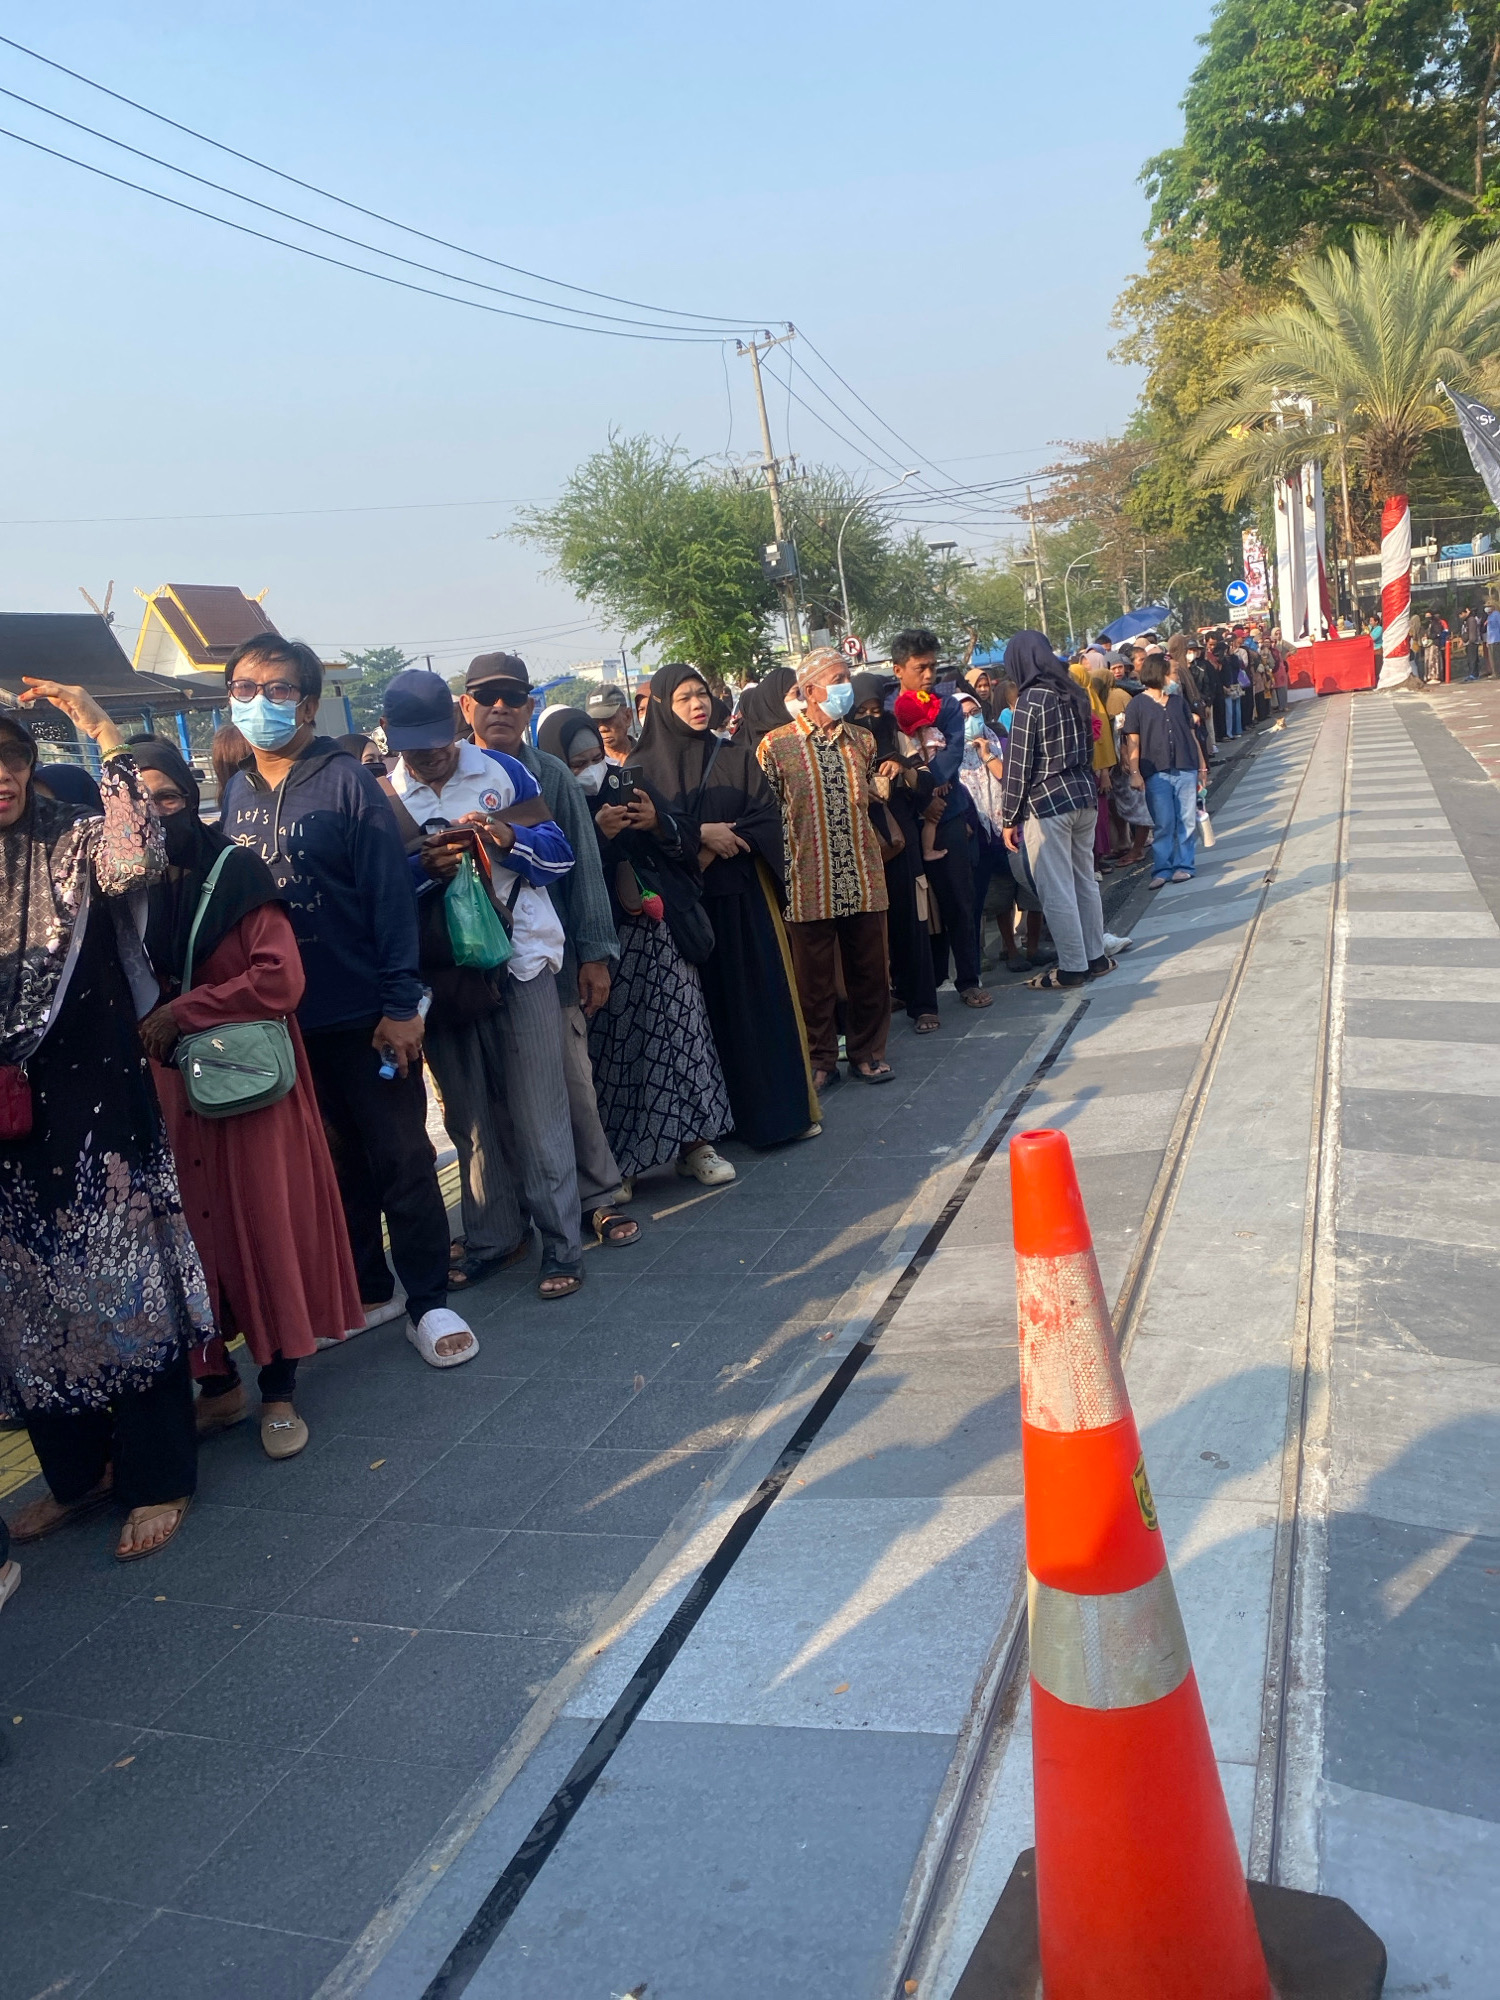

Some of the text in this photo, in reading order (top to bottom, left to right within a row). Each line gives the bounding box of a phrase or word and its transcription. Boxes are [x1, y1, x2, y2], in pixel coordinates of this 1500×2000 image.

[236, 807, 270, 825] Let's
[278, 821, 304, 837] all
[261, 843, 305, 864] Lve
